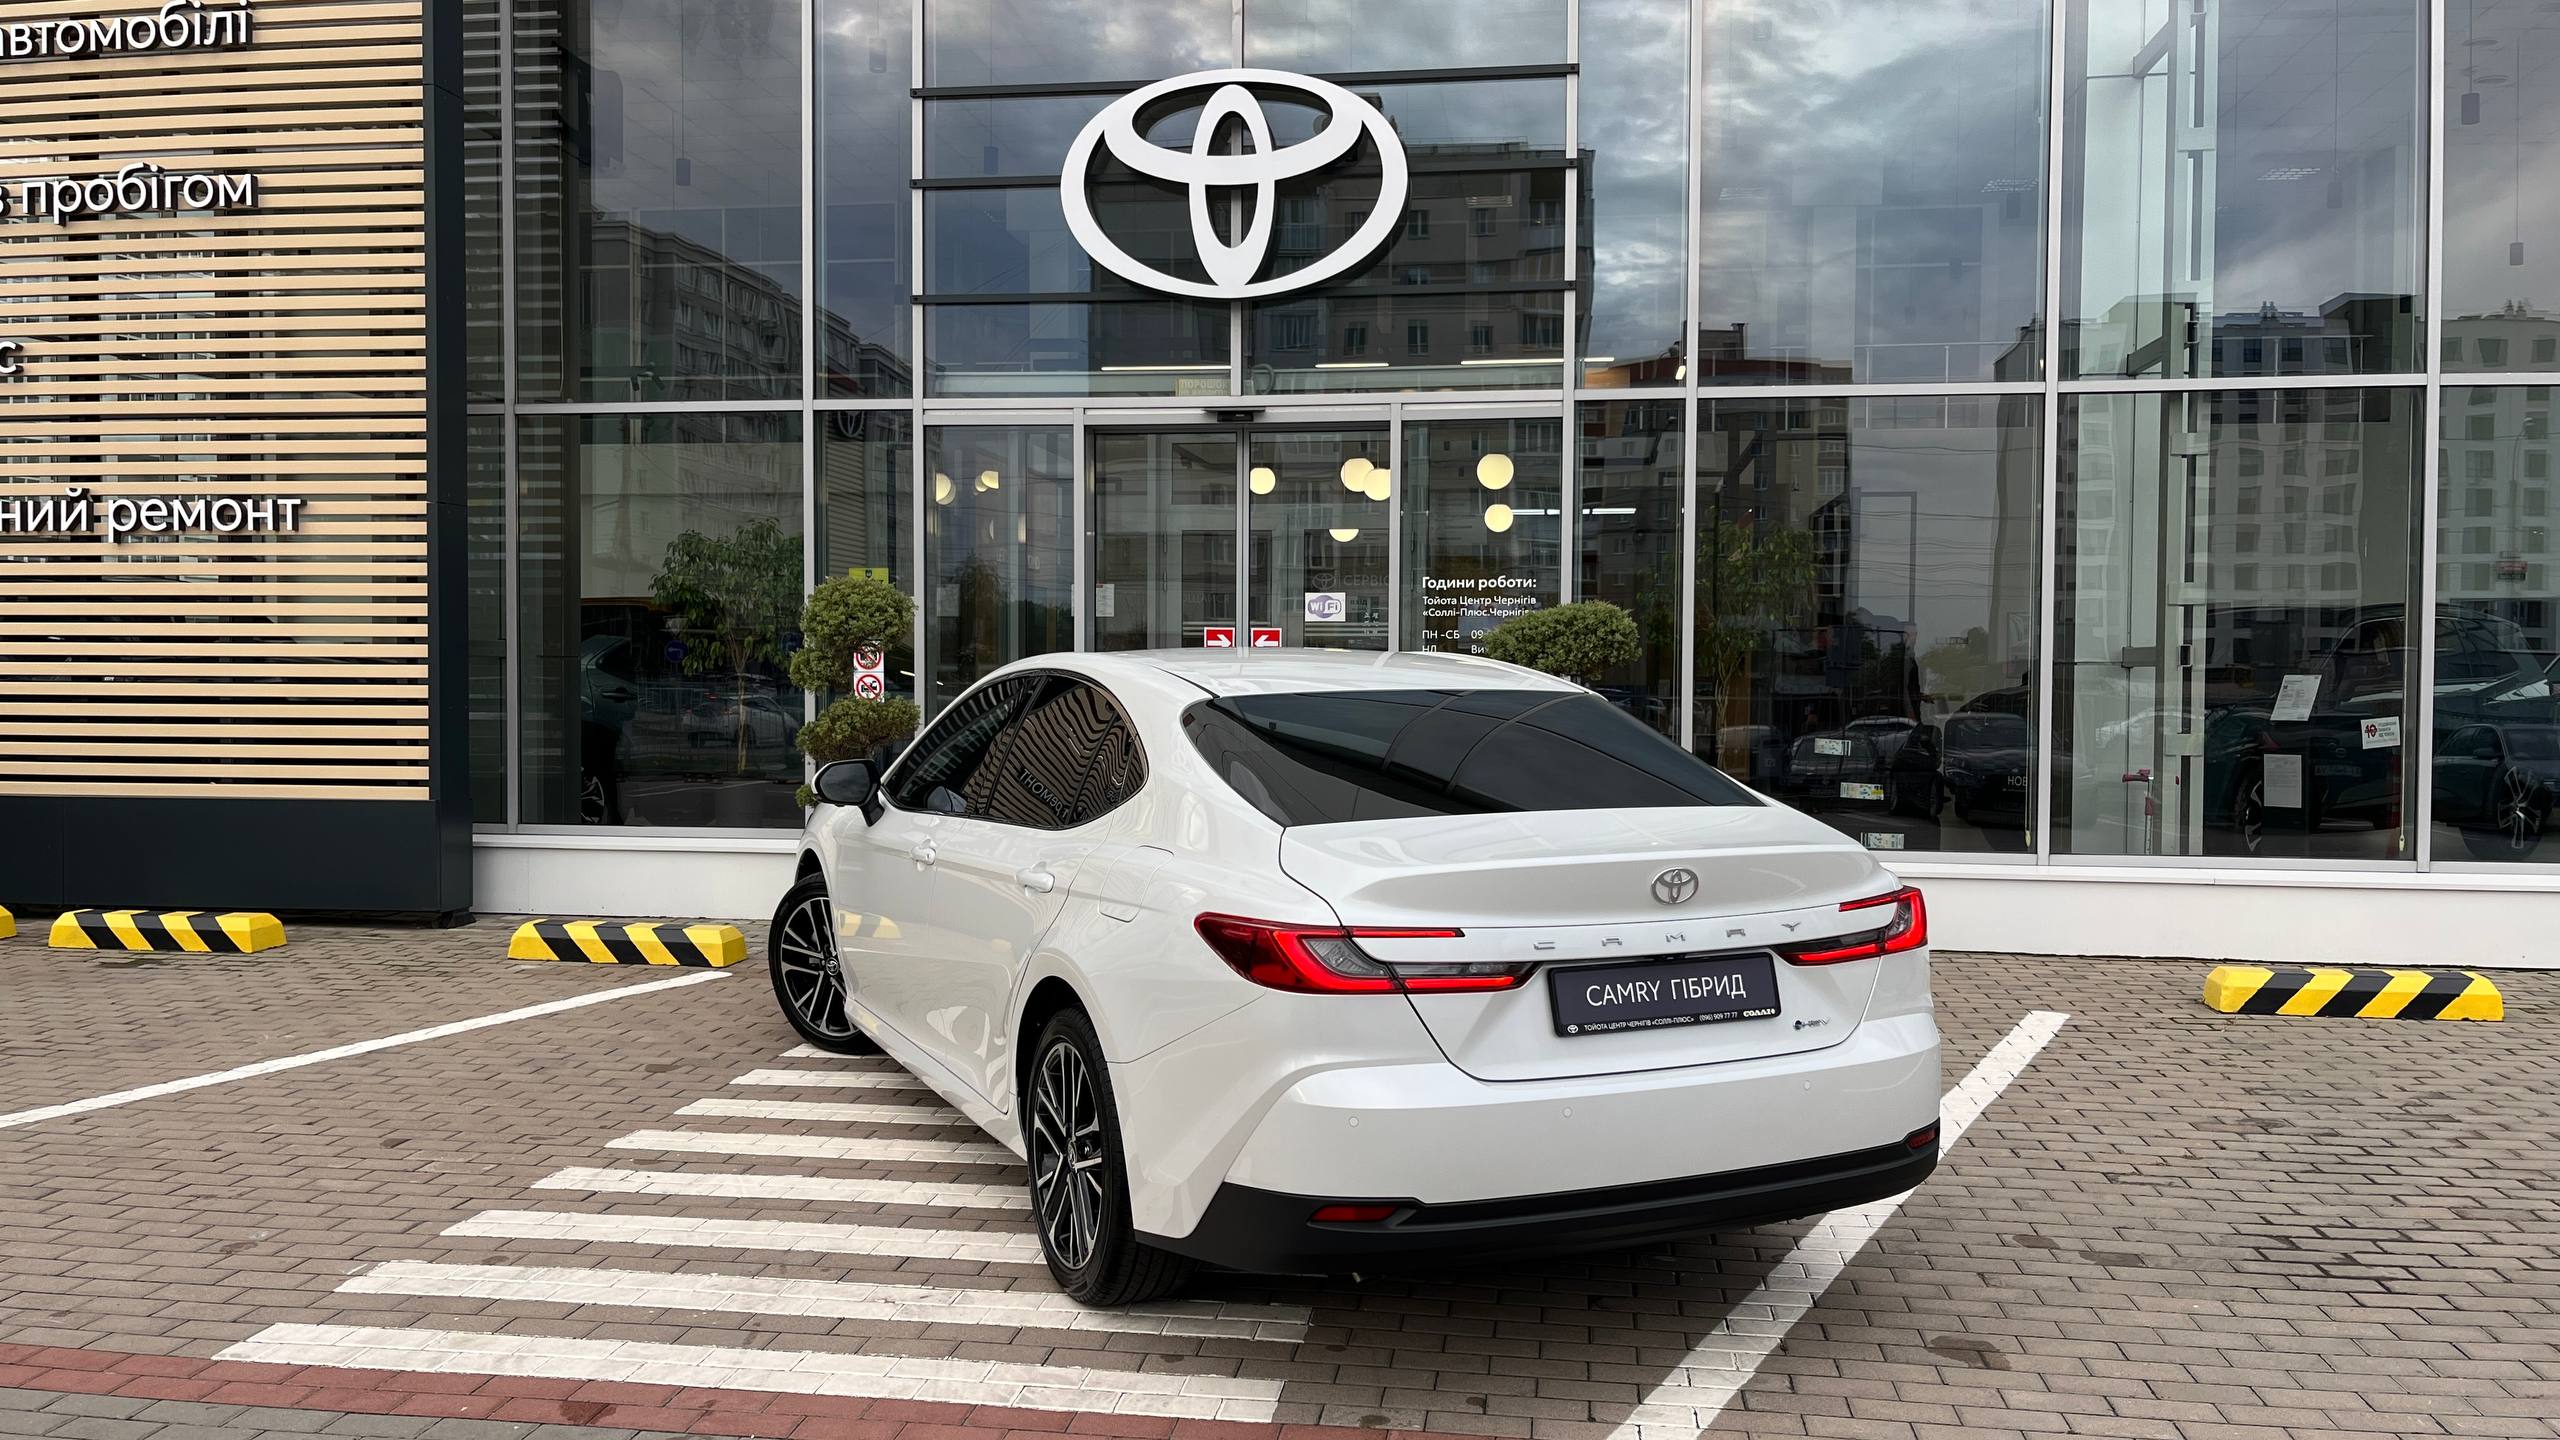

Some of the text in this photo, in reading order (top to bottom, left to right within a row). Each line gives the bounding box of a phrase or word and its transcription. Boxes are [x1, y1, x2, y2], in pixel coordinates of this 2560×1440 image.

[0, 0, 248, 56] втомобілі
[22, 163, 253, 225] пробігом
[108, 497, 303, 543] ремонт
[1421, 575, 1537, 591] Години роботи:
[1422, 595, 1537, 606] Тойота Центр Чернігів
[1422, 630, 1438, 639] ПН
[1533, 921, 1801, 951] CAMRY
[1586, 974, 1747, 1006] CAMRY ГІБРИД
[1584, 1023, 1608, 1031] ТОЙОТА
[1608, 1021, 1627, 1030] ЦЕНТР
